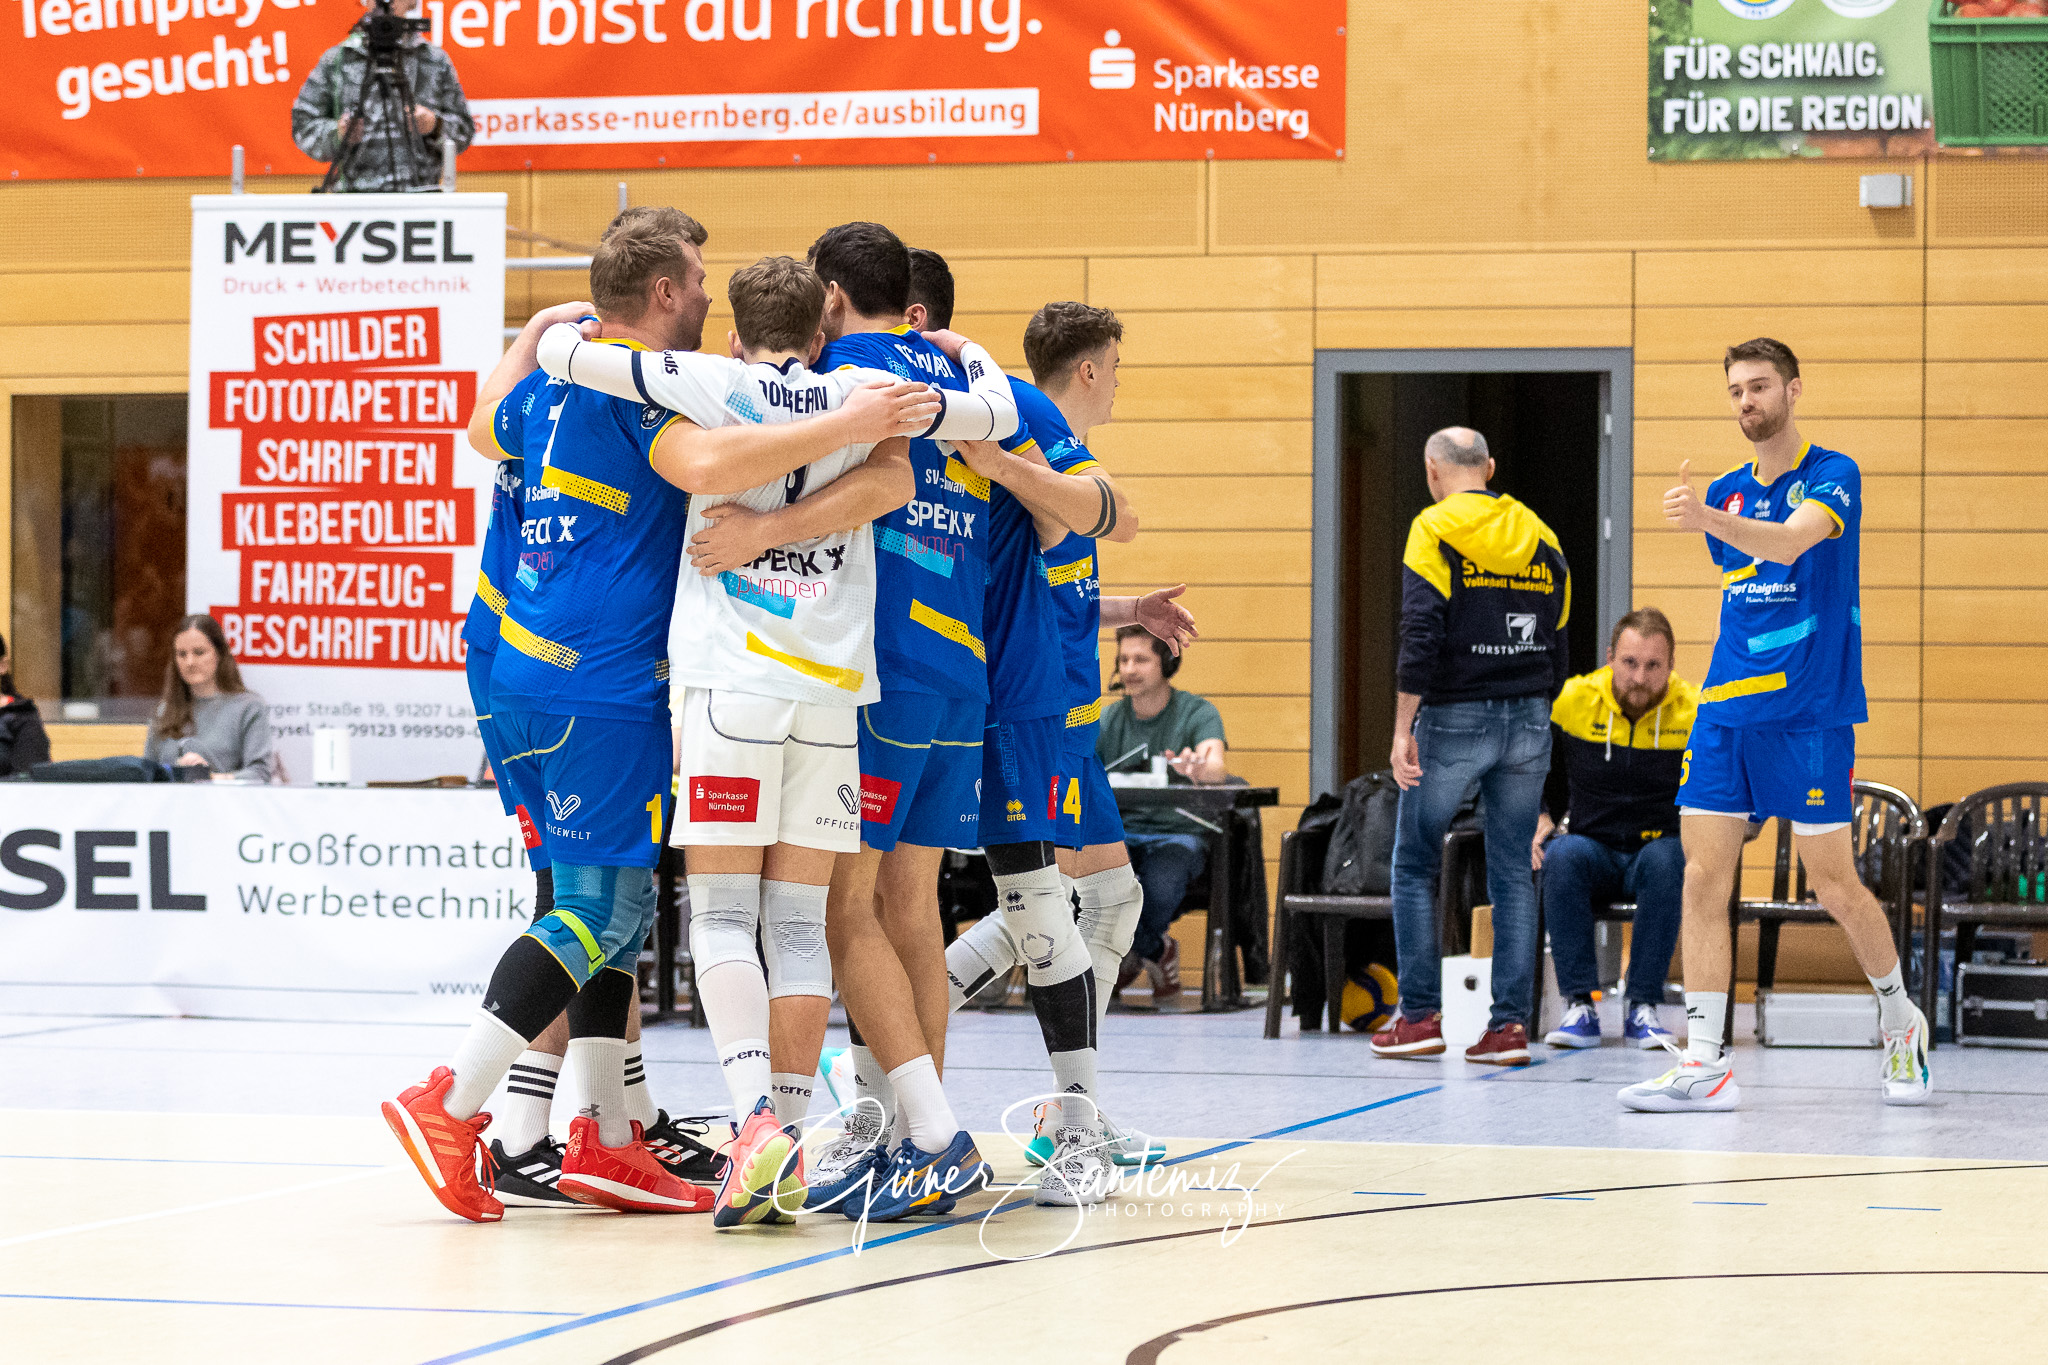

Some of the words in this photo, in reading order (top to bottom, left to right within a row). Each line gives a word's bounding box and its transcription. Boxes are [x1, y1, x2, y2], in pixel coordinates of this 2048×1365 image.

[537, 0, 668, 46] bist
[684, 0, 772, 42] du
[796, 0, 1043, 53] richtig.
[56, 31, 291, 120] gesucht!
[1153, 58, 1320, 96] Sparkasse
[1663, 37, 1732, 80] FÜR
[1737, 41, 1885, 79] SCHWAIG.
[1154, 101, 1310, 139] Nürnberg
[1663, 91, 1731, 134] FÜR
[1738, 97, 1793, 132] DIE
[1801, 94, 1932, 131] REGION.
[224, 220, 475, 264] MEYSEL
[223, 277, 288, 295] Druck
[315, 276, 471, 294] Werbetechnik
[262, 314, 428, 366] SCHILDER
[224, 379, 459, 424] FOTOTAPETEN
[256, 438, 438, 487] SCHRIFTEN
[234, 499, 458, 546] KLEBEFOLIEN
[741, 547, 824, 577] PECK
[251, 560, 446, 608] FAHRZEUG-
[737, 574, 827, 603] pumpen
[222, 613, 469, 664] BESCHRIFTUNG
[395, 704, 442, 718] 91207
[708, 790, 749, 801] Sparkasse
[708, 801, 745, 813] Nürnberg
[1062, 777, 1082, 825] 4
[237, 884, 528, 920] Werbetechnik
[779, 1084, 813, 1098] erre
